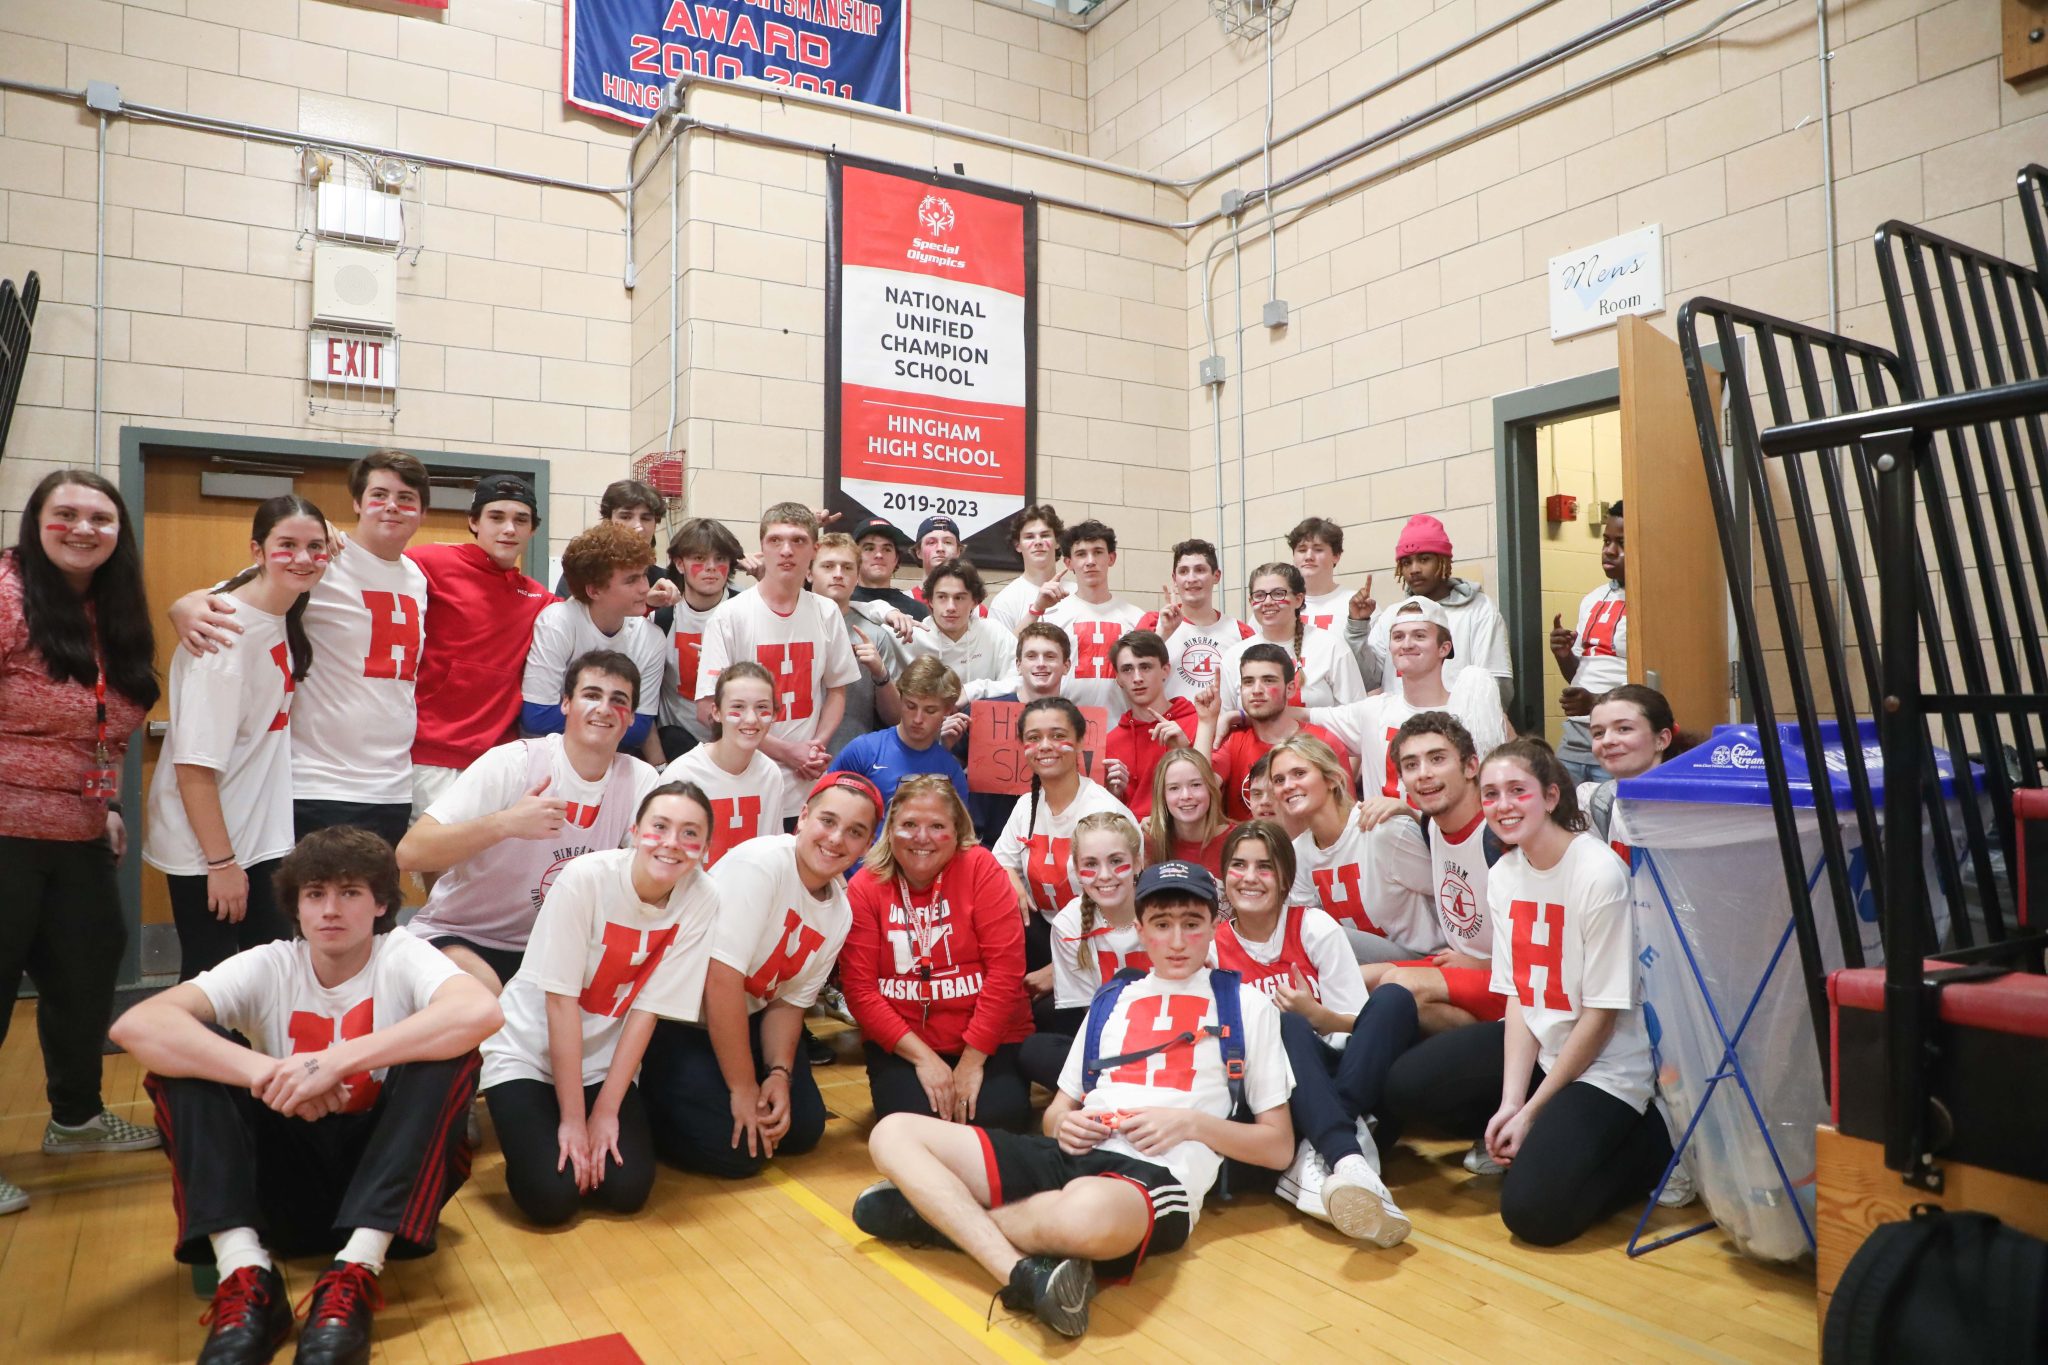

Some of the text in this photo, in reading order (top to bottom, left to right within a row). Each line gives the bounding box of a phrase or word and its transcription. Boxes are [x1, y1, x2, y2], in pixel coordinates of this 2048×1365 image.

[662, 0, 830, 68] AWARD
[602, 72, 664, 111] HING
[906, 249, 967, 269] Olympics
[912, 237, 960, 255] Special
[1562, 254, 1645, 290] Mens
[885, 286, 986, 318] NATIONAL
[1599, 293, 1642, 316] Room
[896, 311, 974, 339] UNIFIED
[328, 337, 384, 380] EXIT
[880, 333, 989, 364] CHAMPION
[894, 359, 975, 387] SCHOOL
[888, 414, 981, 443] HINGHAM
[867, 436, 1001, 468] HIGH SCHOOL
[882, 492, 979, 518] 2019-2023
[362, 590, 420, 681] H
[1073, 621, 1122, 679] H
[757, 642, 814, 722] H
[1027, 834, 1081, 912] H
[888, 899, 951, 925] UNFIED
[1312, 863, 1387, 937] H
[578, 921, 680, 1018] H
[744, 908, 825, 1000] H
[1509, 900, 1573, 1012] H
[878, 973, 983, 1001] BASKTBALL
[1110, 995, 1210, 1092] H
